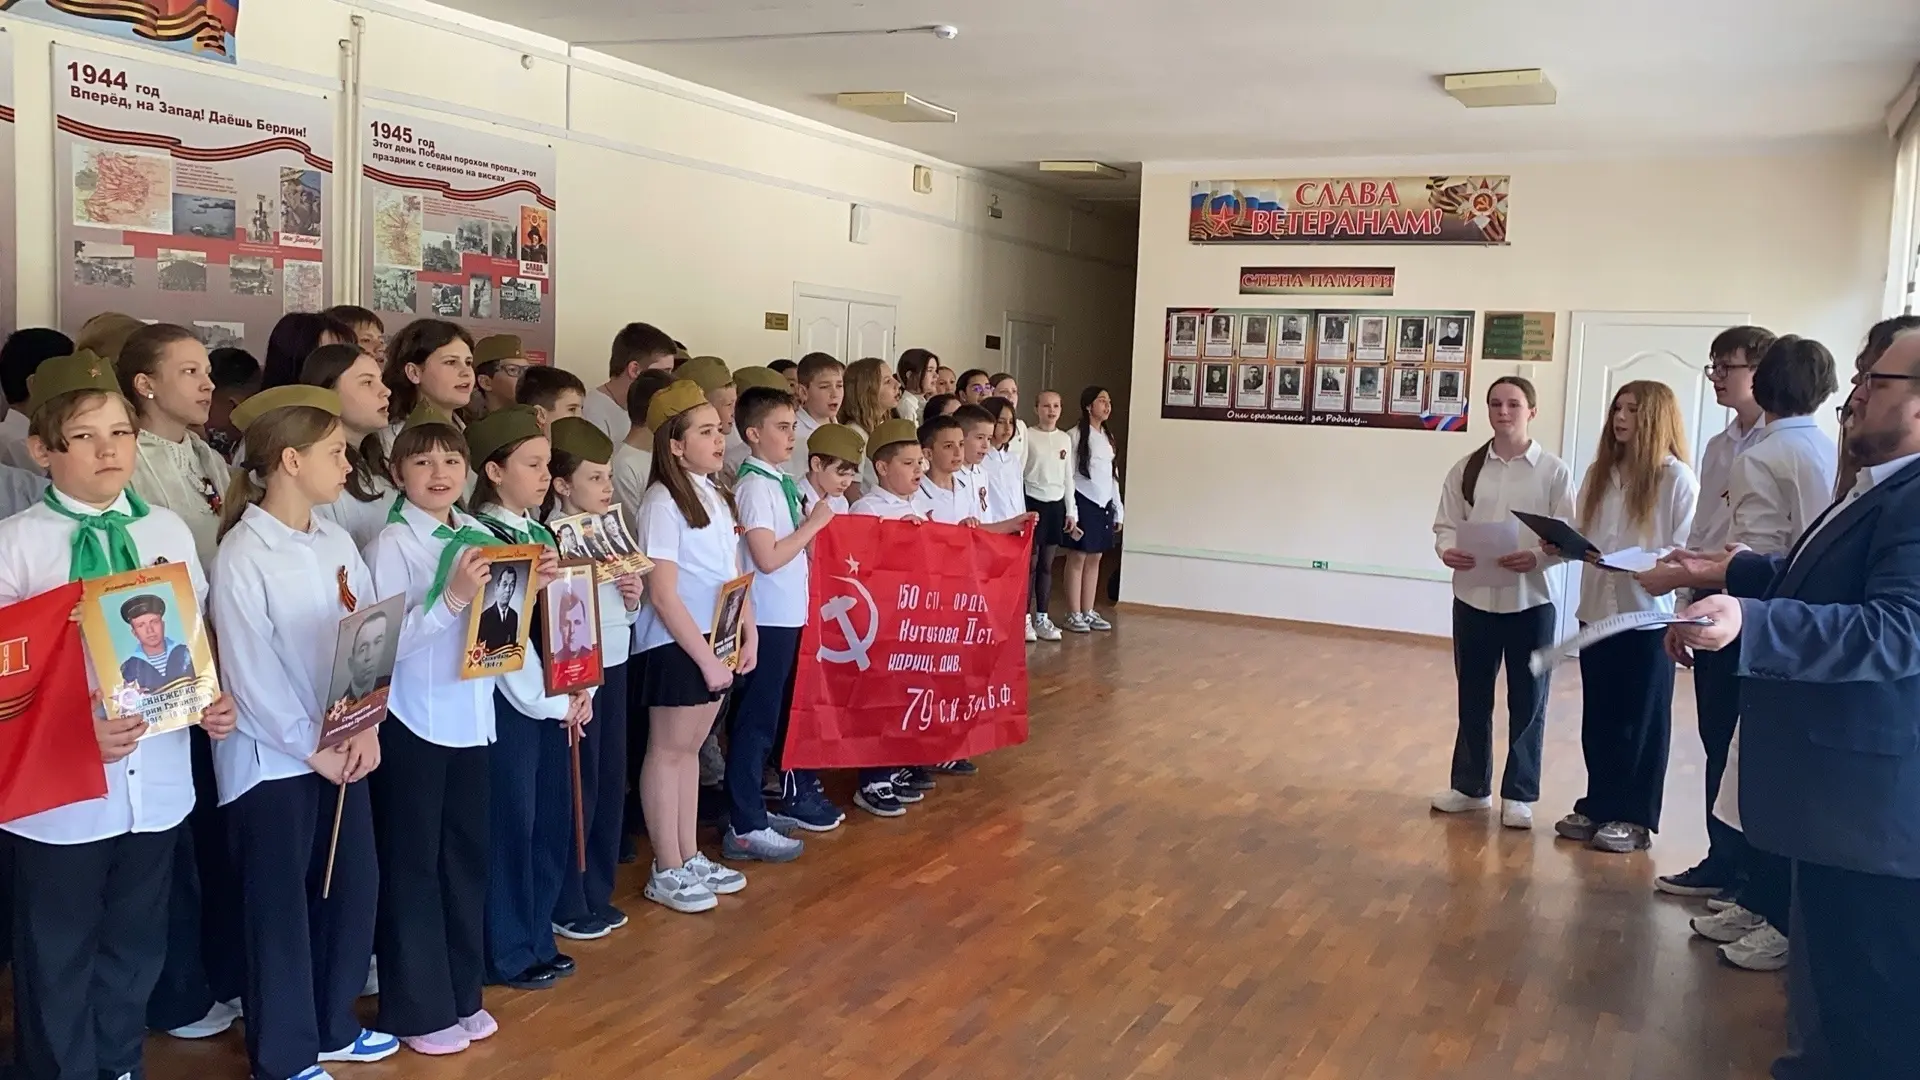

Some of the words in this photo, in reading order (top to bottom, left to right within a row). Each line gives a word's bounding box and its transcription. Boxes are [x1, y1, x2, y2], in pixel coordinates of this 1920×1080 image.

[67, 61, 128, 90] 1944
[136, 82, 160, 98] год
[70, 85, 132, 109] Вперёд,
[137, 101, 154, 111] на
[159, 101, 205, 121] Запад!
[209, 111, 252, 128] Даёшь
[256, 119, 307, 137] Берлин!
[370, 121, 412, 143] 1945
[418, 138, 435, 149] год
[372, 139, 393, 150] Этот
[395, 143, 416, 155] день
[419, 148, 451, 161] Победы
[454, 155, 488, 168] порохом
[490, 162, 520, 175] пропах,
[521, 168, 537, 178] этот
[372, 153, 416, 166] праздник
[426, 161, 464, 175] сединою
[466, 169, 476, 177] на
[478, 171, 505, 182] висках
[1295, 181, 1400, 207] СЛАВА
[1251, 208, 1444, 235] ВЕТЕРАНАМ!
[526, 262, 544, 271] СЛАВА
[1241, 273, 1304, 288] СТЕНА
[1310, 273, 1394, 288] ПАМЯТИ
[1227, 410, 1249, 419] Они
[1250, 412, 1305, 422] сражались
[1310, 415, 1324, 423] за
[1325, 413, 1368, 425] Родину...
[897, 584, 920, 610] 150
[901, 687, 934, 732] 79
